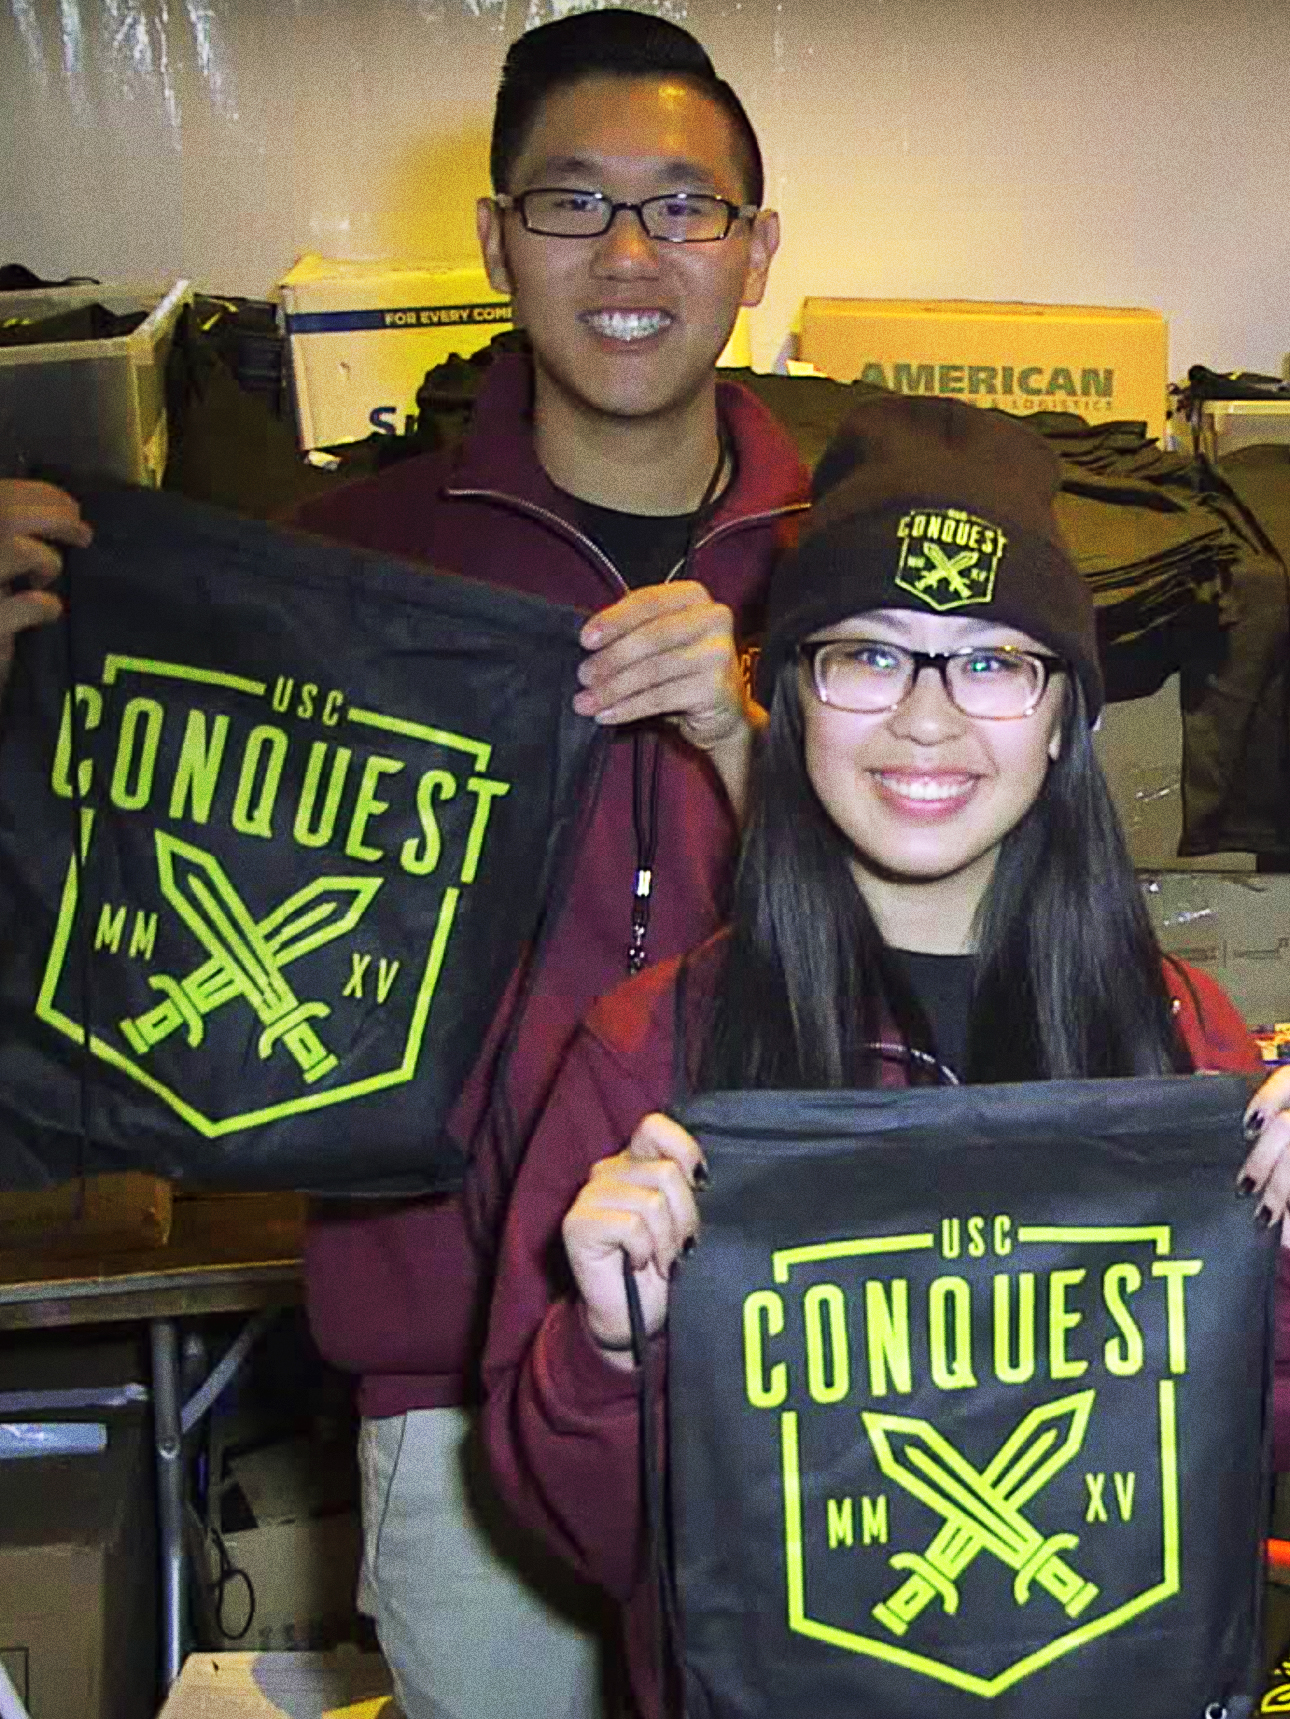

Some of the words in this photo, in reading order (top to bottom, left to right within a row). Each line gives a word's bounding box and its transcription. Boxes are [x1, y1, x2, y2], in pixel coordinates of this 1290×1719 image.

[384, 312, 418, 327] FOR
[420, 309, 471, 325] EVERY
[860, 362, 1114, 398] AMERICAN
[896, 514, 1007, 558] CONQUEST
[271, 676, 344, 726] USC
[50, 684, 511, 884] CONQUEST
[95, 903, 159, 960] MM
[342, 952, 400, 1005] XV
[941, 1214, 1013, 1259] USC
[742, 1259, 1203, 1409] CONQUEST
[826, 1494, 889, 1549] MM
[1085, 1471, 1136, 1523] XV
